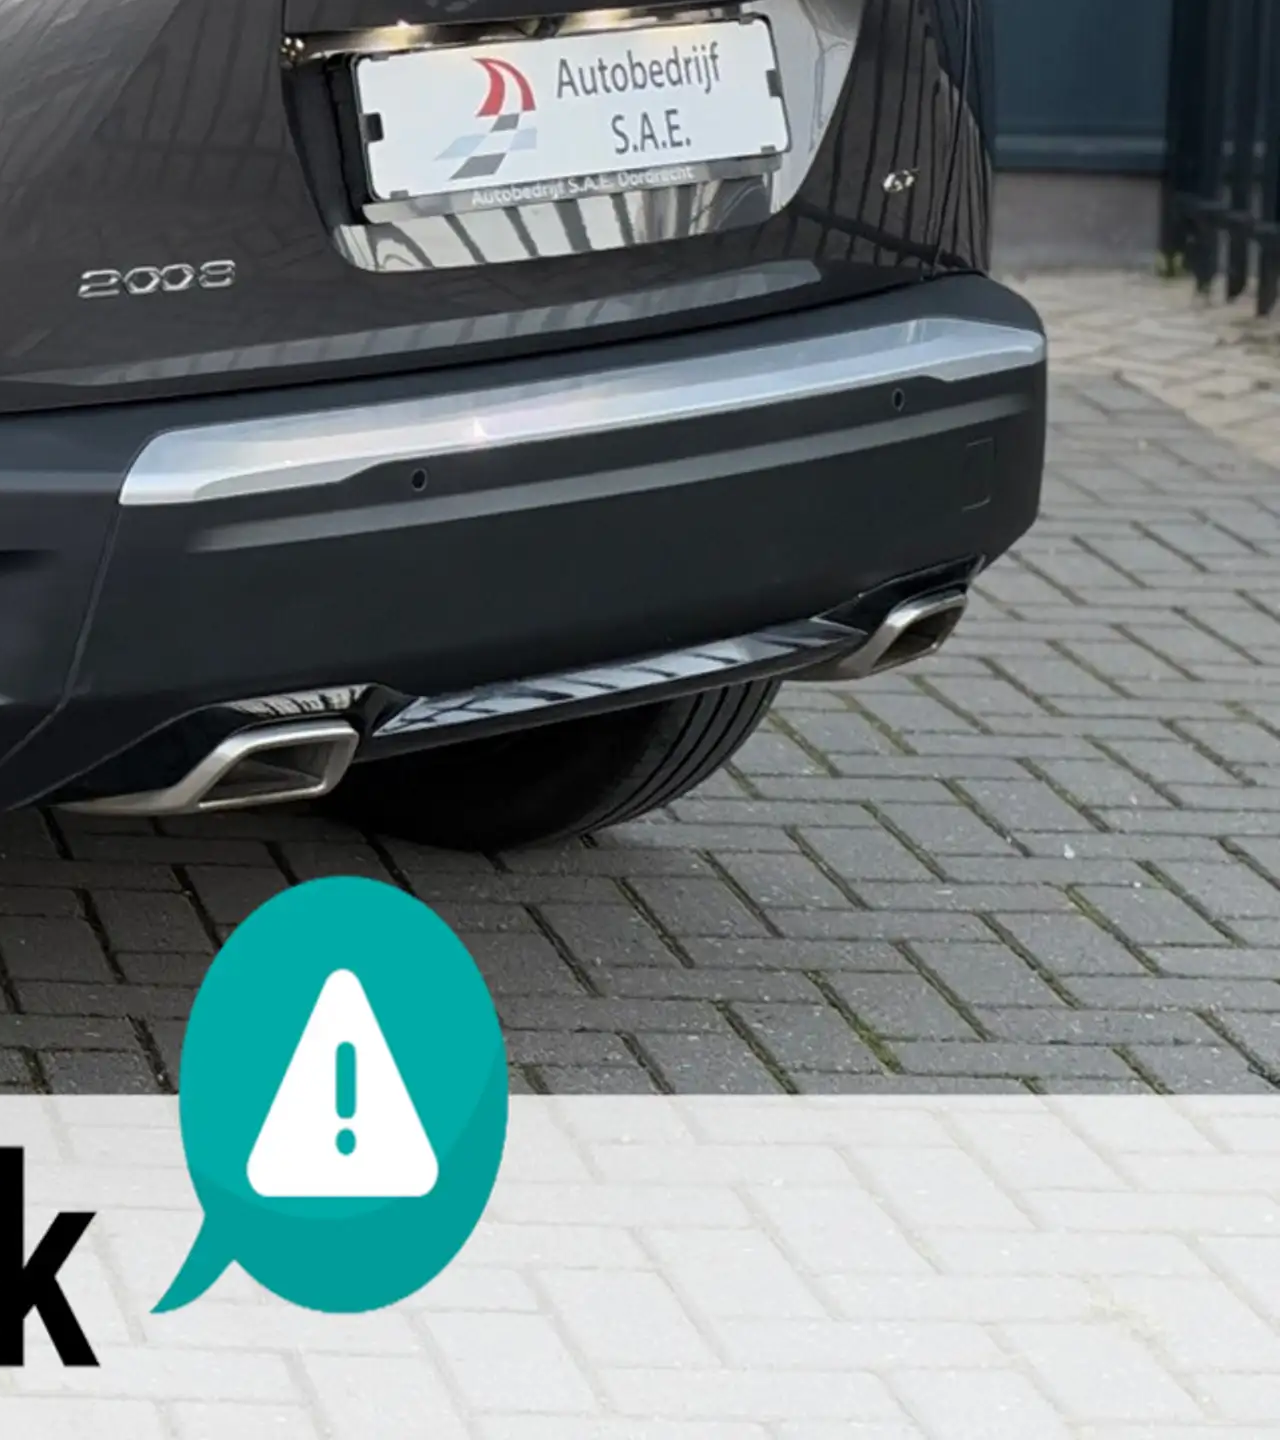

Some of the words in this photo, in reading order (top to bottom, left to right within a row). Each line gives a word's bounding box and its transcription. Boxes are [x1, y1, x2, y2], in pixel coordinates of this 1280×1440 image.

[556, 41, 721, 99] Autobedrijf
[611, 108, 692, 155] S.A.E.
[471, 181, 565, 207] Autobedrijf
[78, 259, 237, 299] 2008
